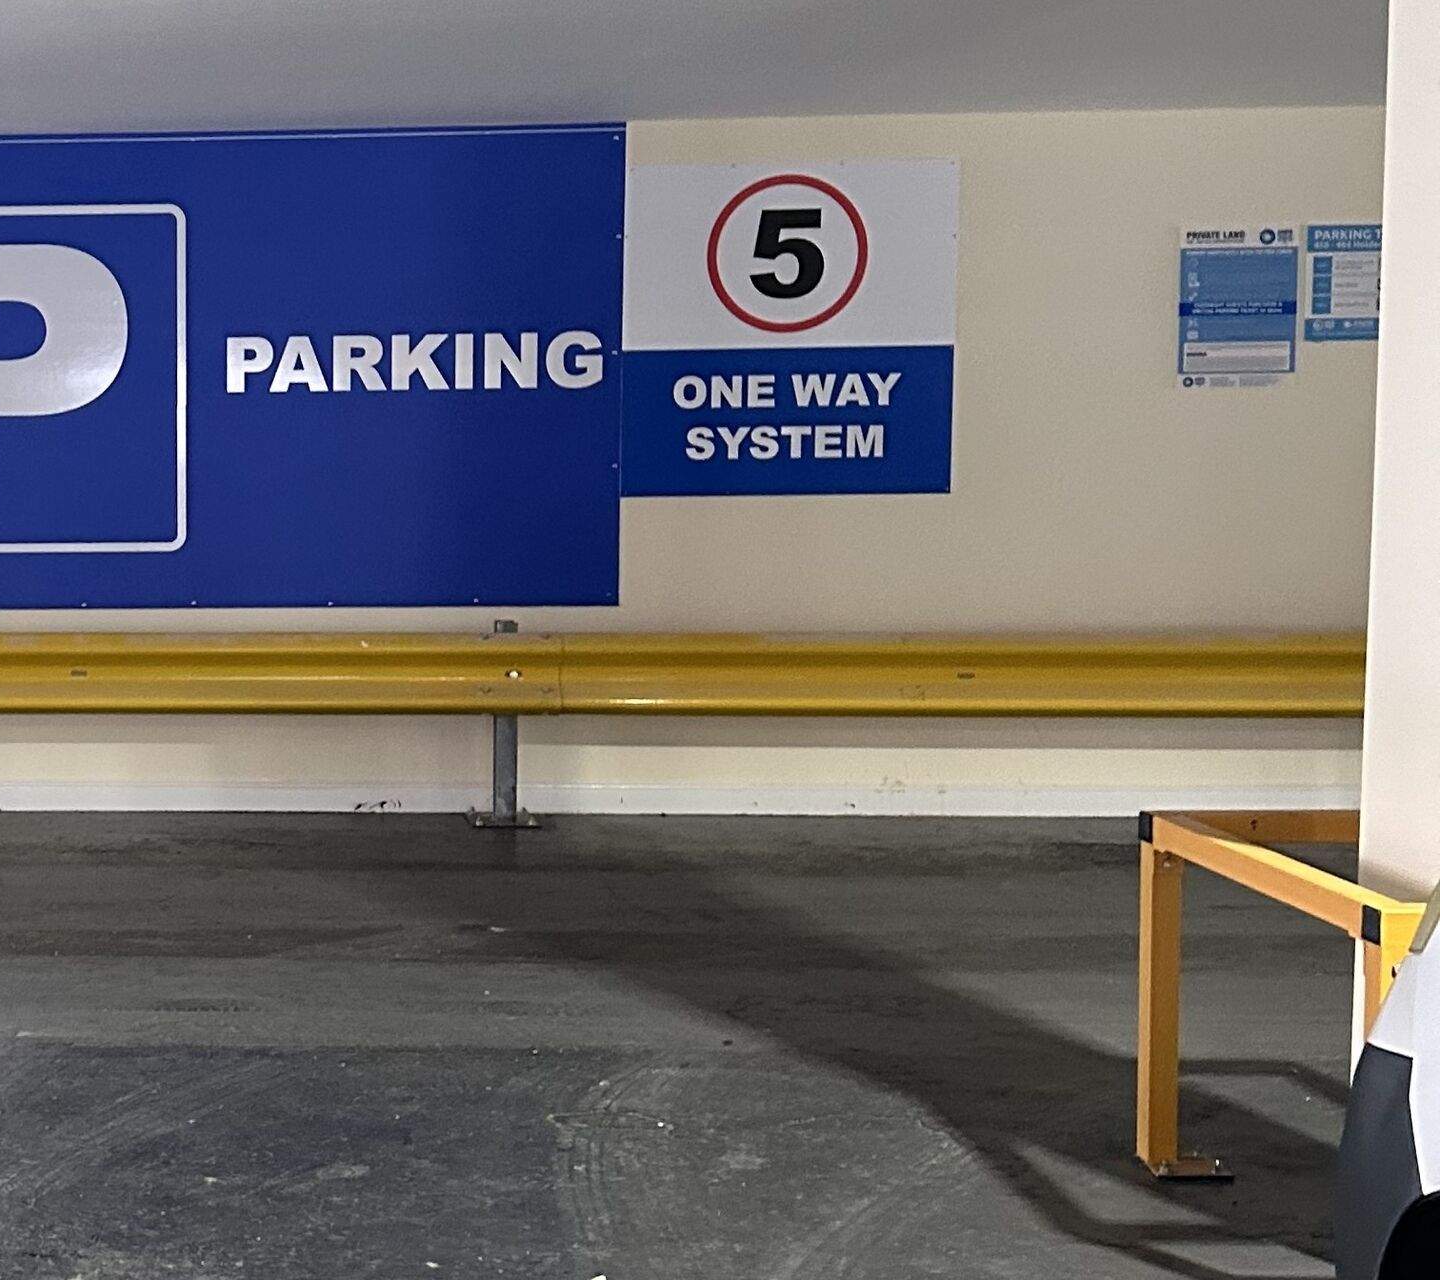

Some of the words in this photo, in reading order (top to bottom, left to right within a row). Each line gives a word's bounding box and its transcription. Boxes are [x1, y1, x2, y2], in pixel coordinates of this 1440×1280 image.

[1186, 230, 1220, 240] PRIVATE
[1223, 230, 1246, 239] LAND
[1315, 229, 1372, 239] PARKING
[749, 208, 825, 300] 5
[225, 330, 605, 395] PARKING
[672, 374, 776, 411] ONE
[790, 372, 902, 408] WAY
[685, 424, 885, 461] SYSTEM
